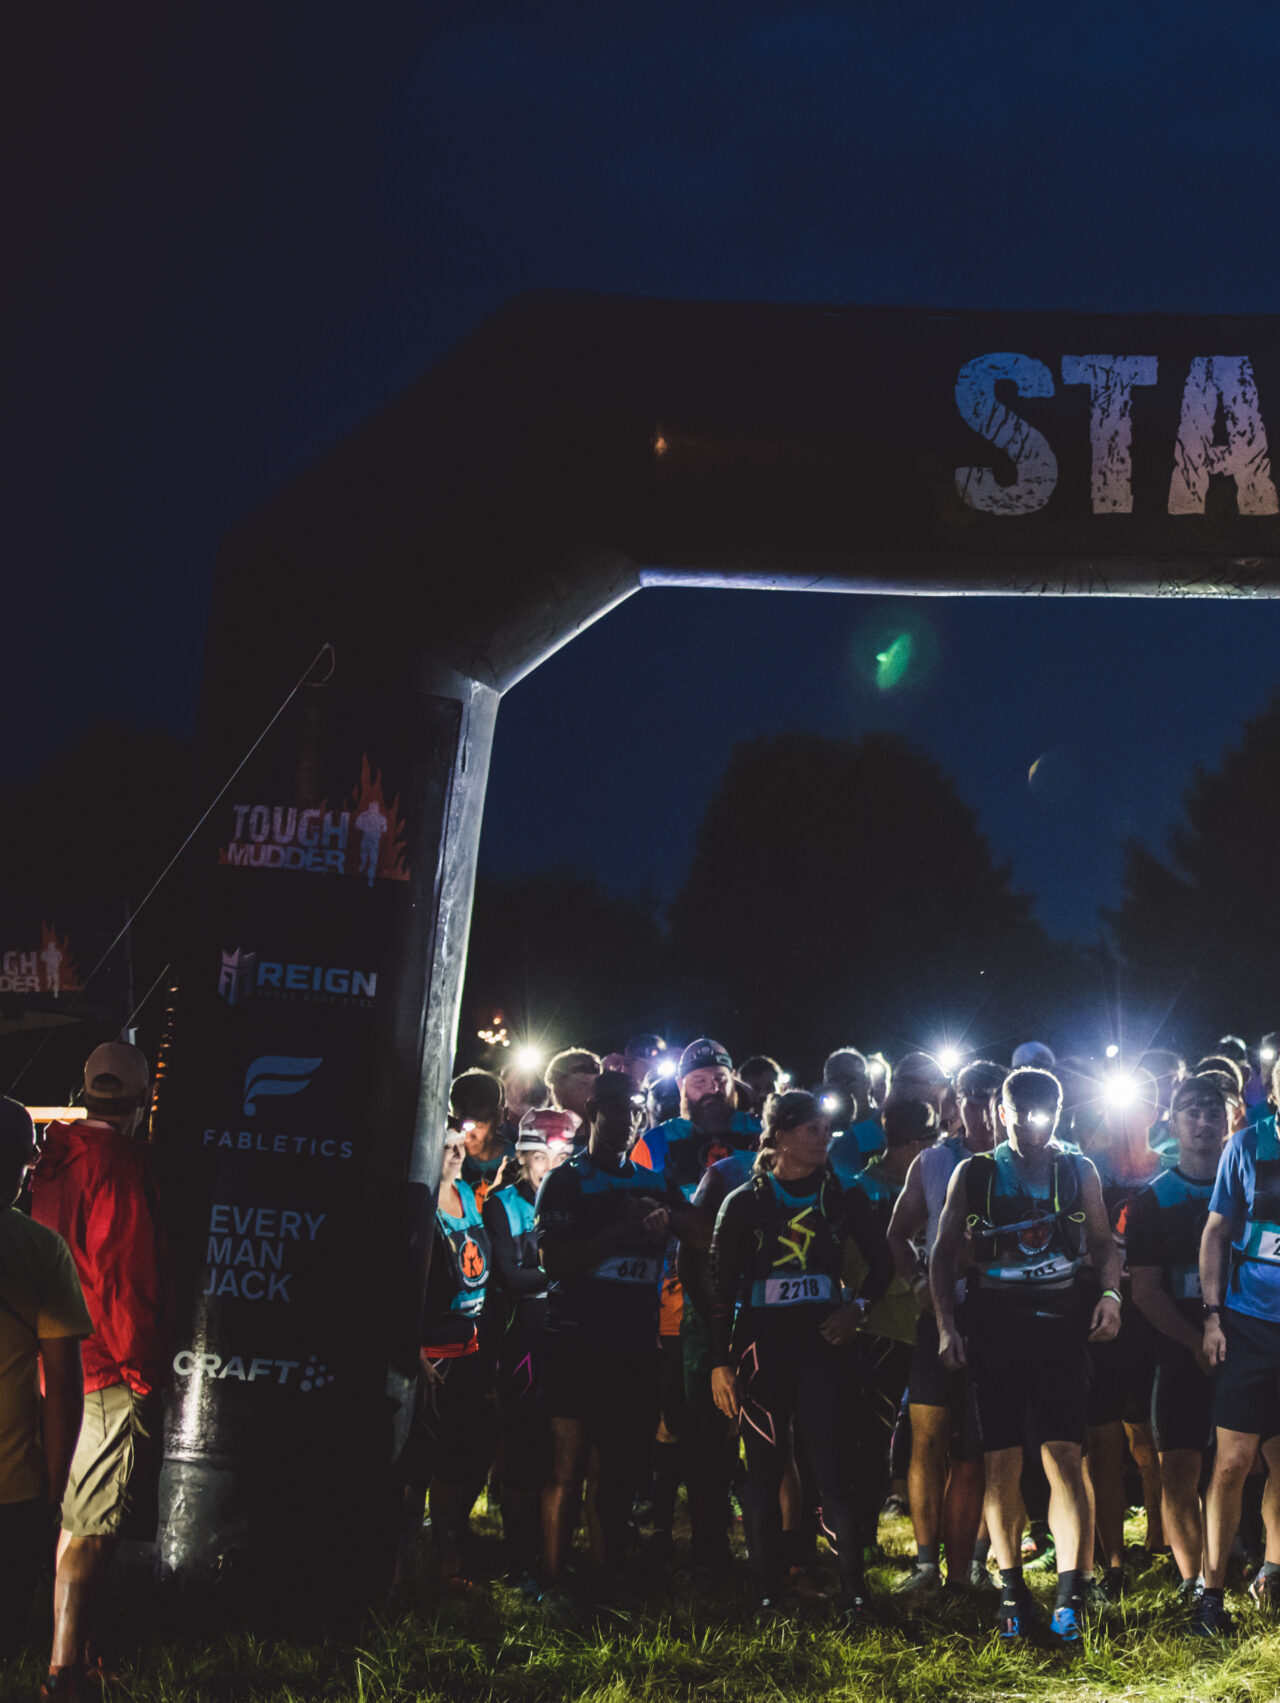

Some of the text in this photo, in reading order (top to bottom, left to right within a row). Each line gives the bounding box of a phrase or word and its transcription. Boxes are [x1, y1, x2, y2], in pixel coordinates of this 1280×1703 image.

[233, 804, 350, 849] TOUGH
[228, 842, 346, 874] MUDDER
[256, 961, 377, 997] REIGN
[203, 1128, 352, 1159] FABLETICS
[210, 1204, 326, 1241] EVERY
[206, 1236, 284, 1270] MAN
[203, 1267, 292, 1302] JACK
[779, 1278, 819, 1300] 2218
[173, 1350, 300, 1384] CRAFT
